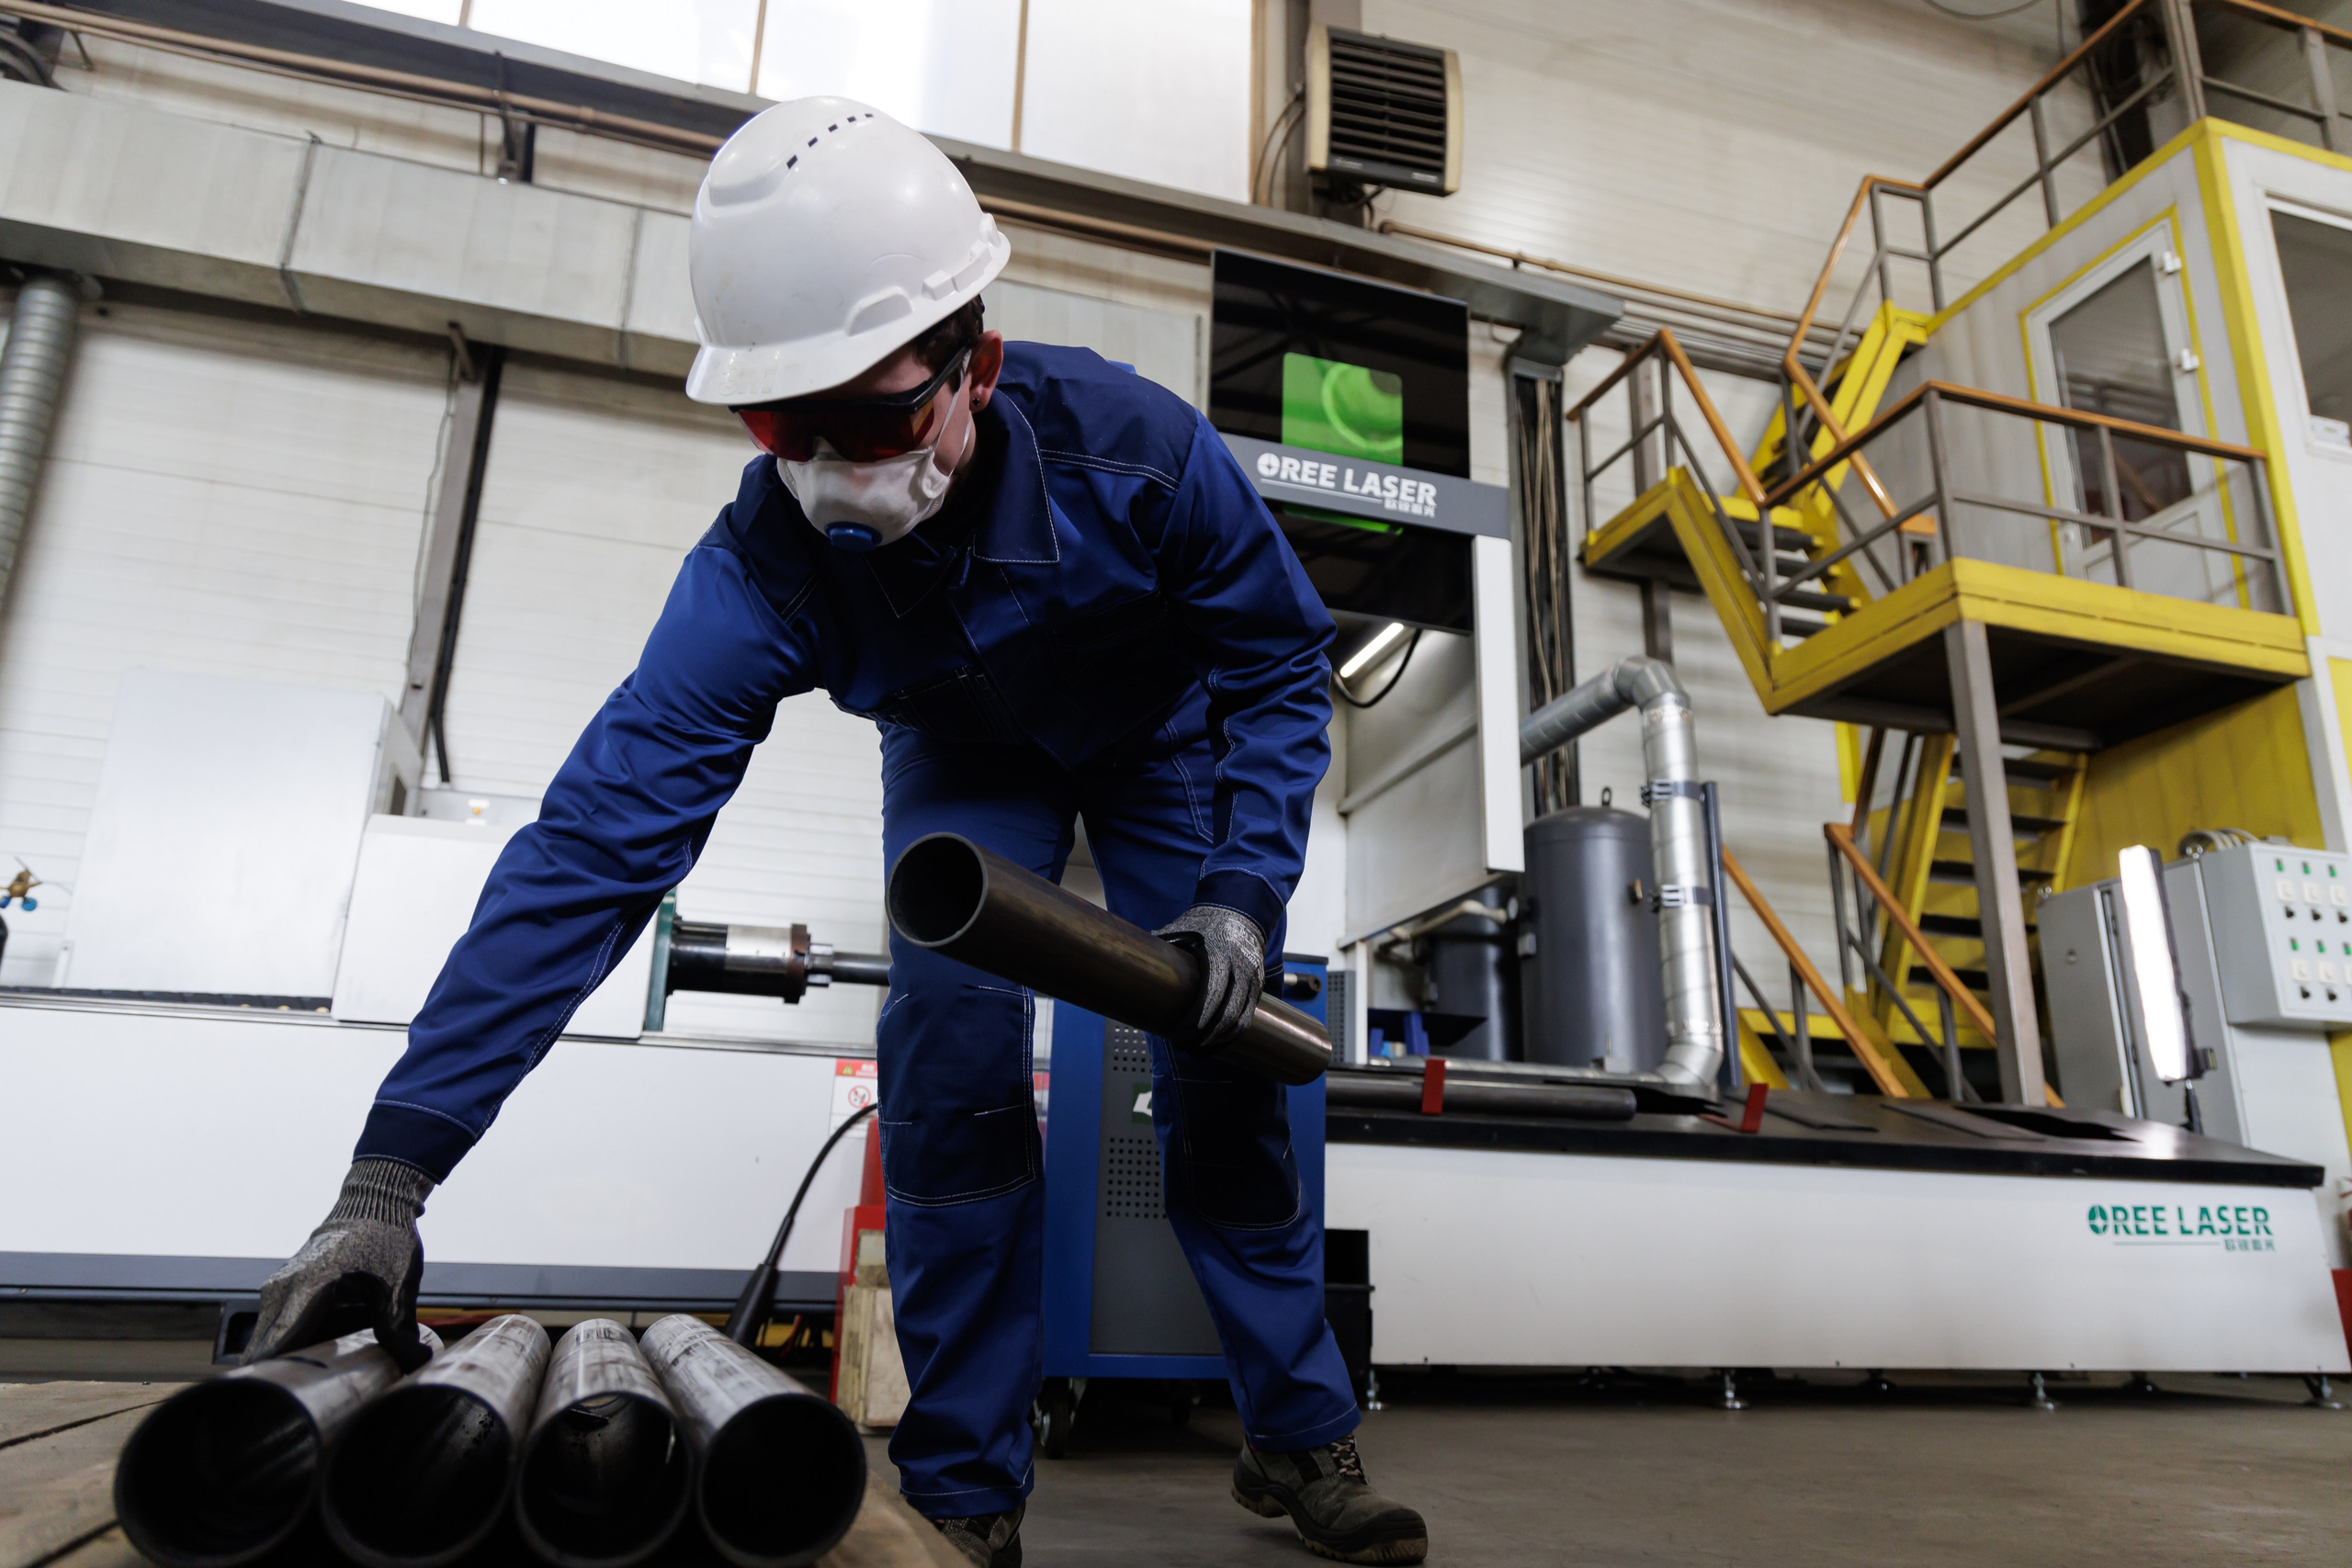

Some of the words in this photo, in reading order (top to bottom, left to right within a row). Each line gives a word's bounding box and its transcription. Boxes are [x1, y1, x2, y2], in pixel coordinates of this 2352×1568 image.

[1257, 453, 1338, 489] OREE
[1343, 468, 1437, 506] LASER
[2088, 1205, 2168, 1235] OREE
[2177, 1206, 2273, 1235] LASER
